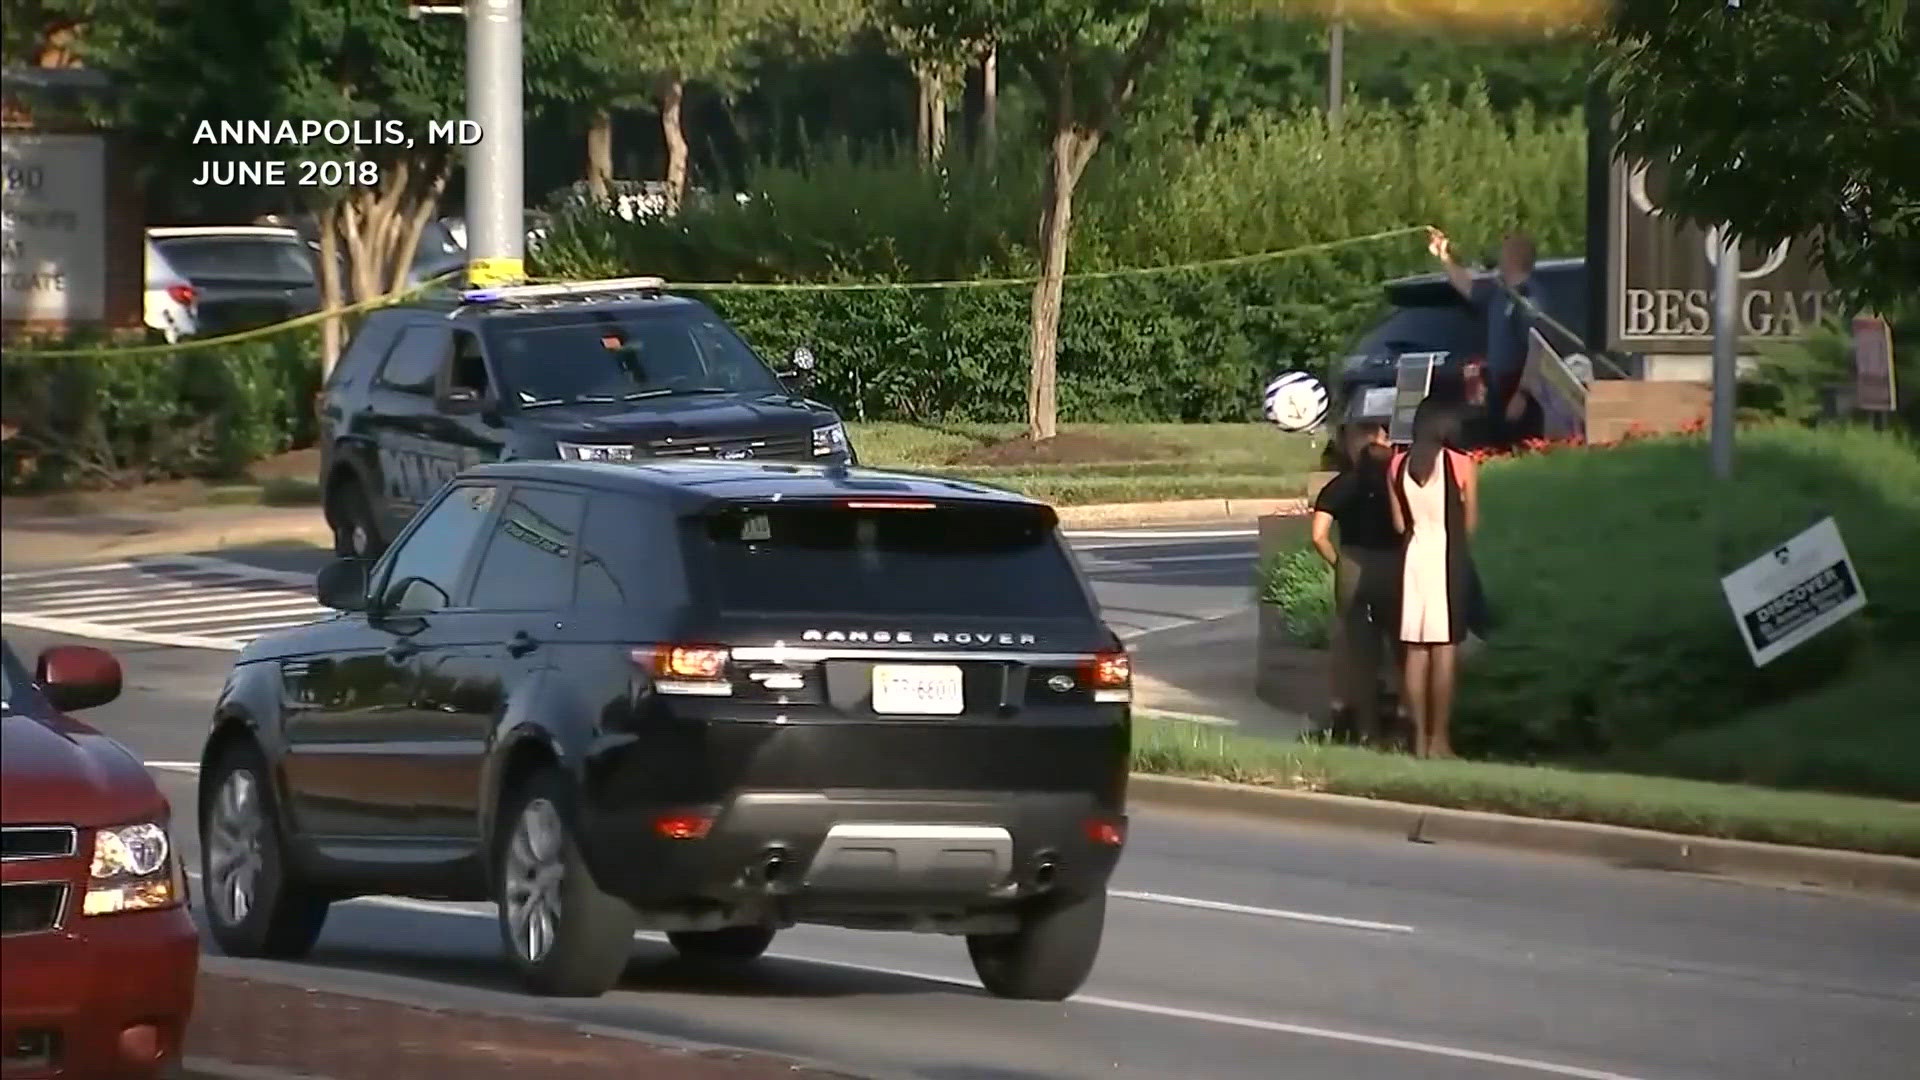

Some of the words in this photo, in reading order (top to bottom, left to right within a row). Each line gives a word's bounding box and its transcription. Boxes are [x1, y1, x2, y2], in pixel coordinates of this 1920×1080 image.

[1755, 567, 1839, 623] DISCOVER
[802, 629, 913, 643] RANGE
[932, 632, 1035, 645] ROVER
